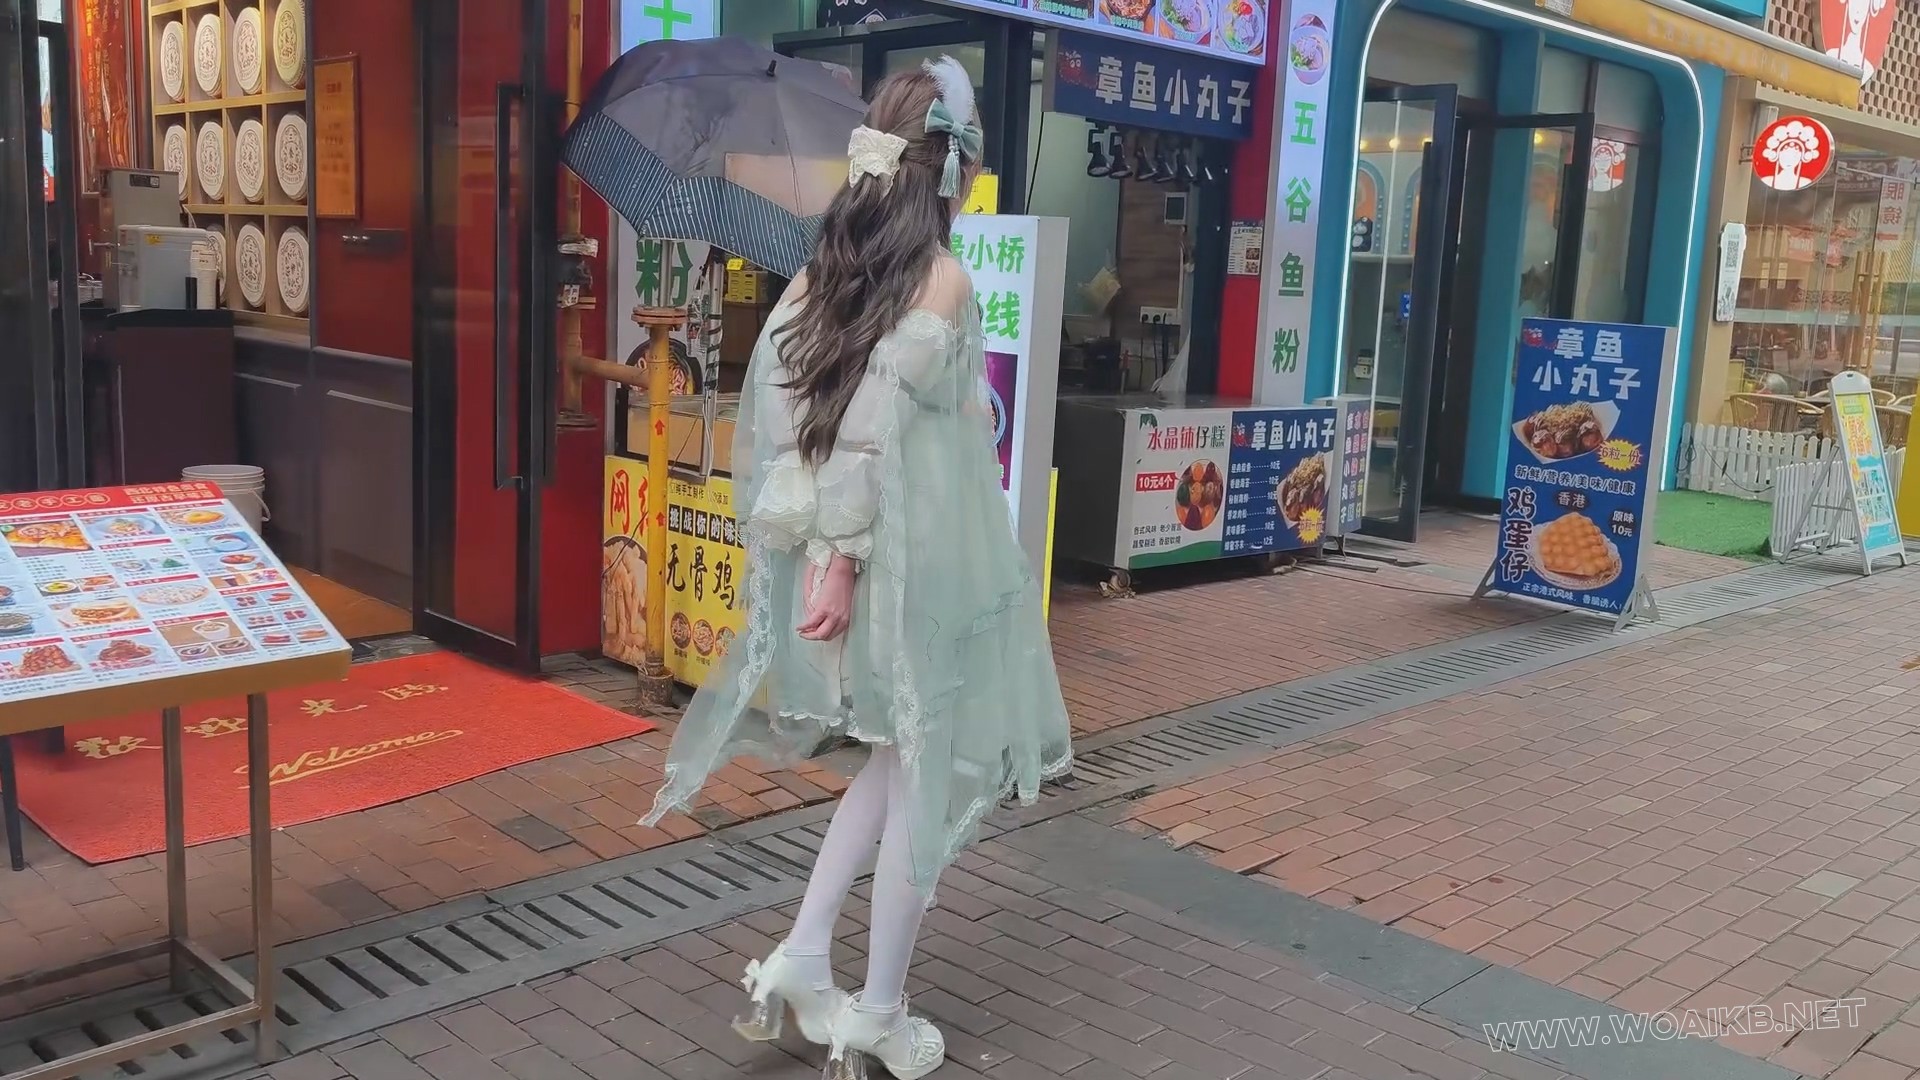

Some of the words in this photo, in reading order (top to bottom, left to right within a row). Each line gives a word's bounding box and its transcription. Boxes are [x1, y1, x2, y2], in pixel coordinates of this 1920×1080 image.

[1095, 56, 1250, 124] 章鱼小丸子
[1272, 101, 1317, 373] 五谷鱼粉
[976, 291, 1020, 340] 线
[1554, 328, 1623, 363] 章鱼
[1532, 360, 1640, 400] 小丸子
[1251, 418, 1335, 451] 章鱼小丸子
[1138, 474, 1173, 489] 10元4个
[1558, 491, 1586, 509] 香港
[1500, 485, 1538, 584] 鸡蛋仔
[1611, 524, 1633, 538] 10元
[1612, 510, 1634, 524] 原味
[233, 729, 463, 790] Welcome
